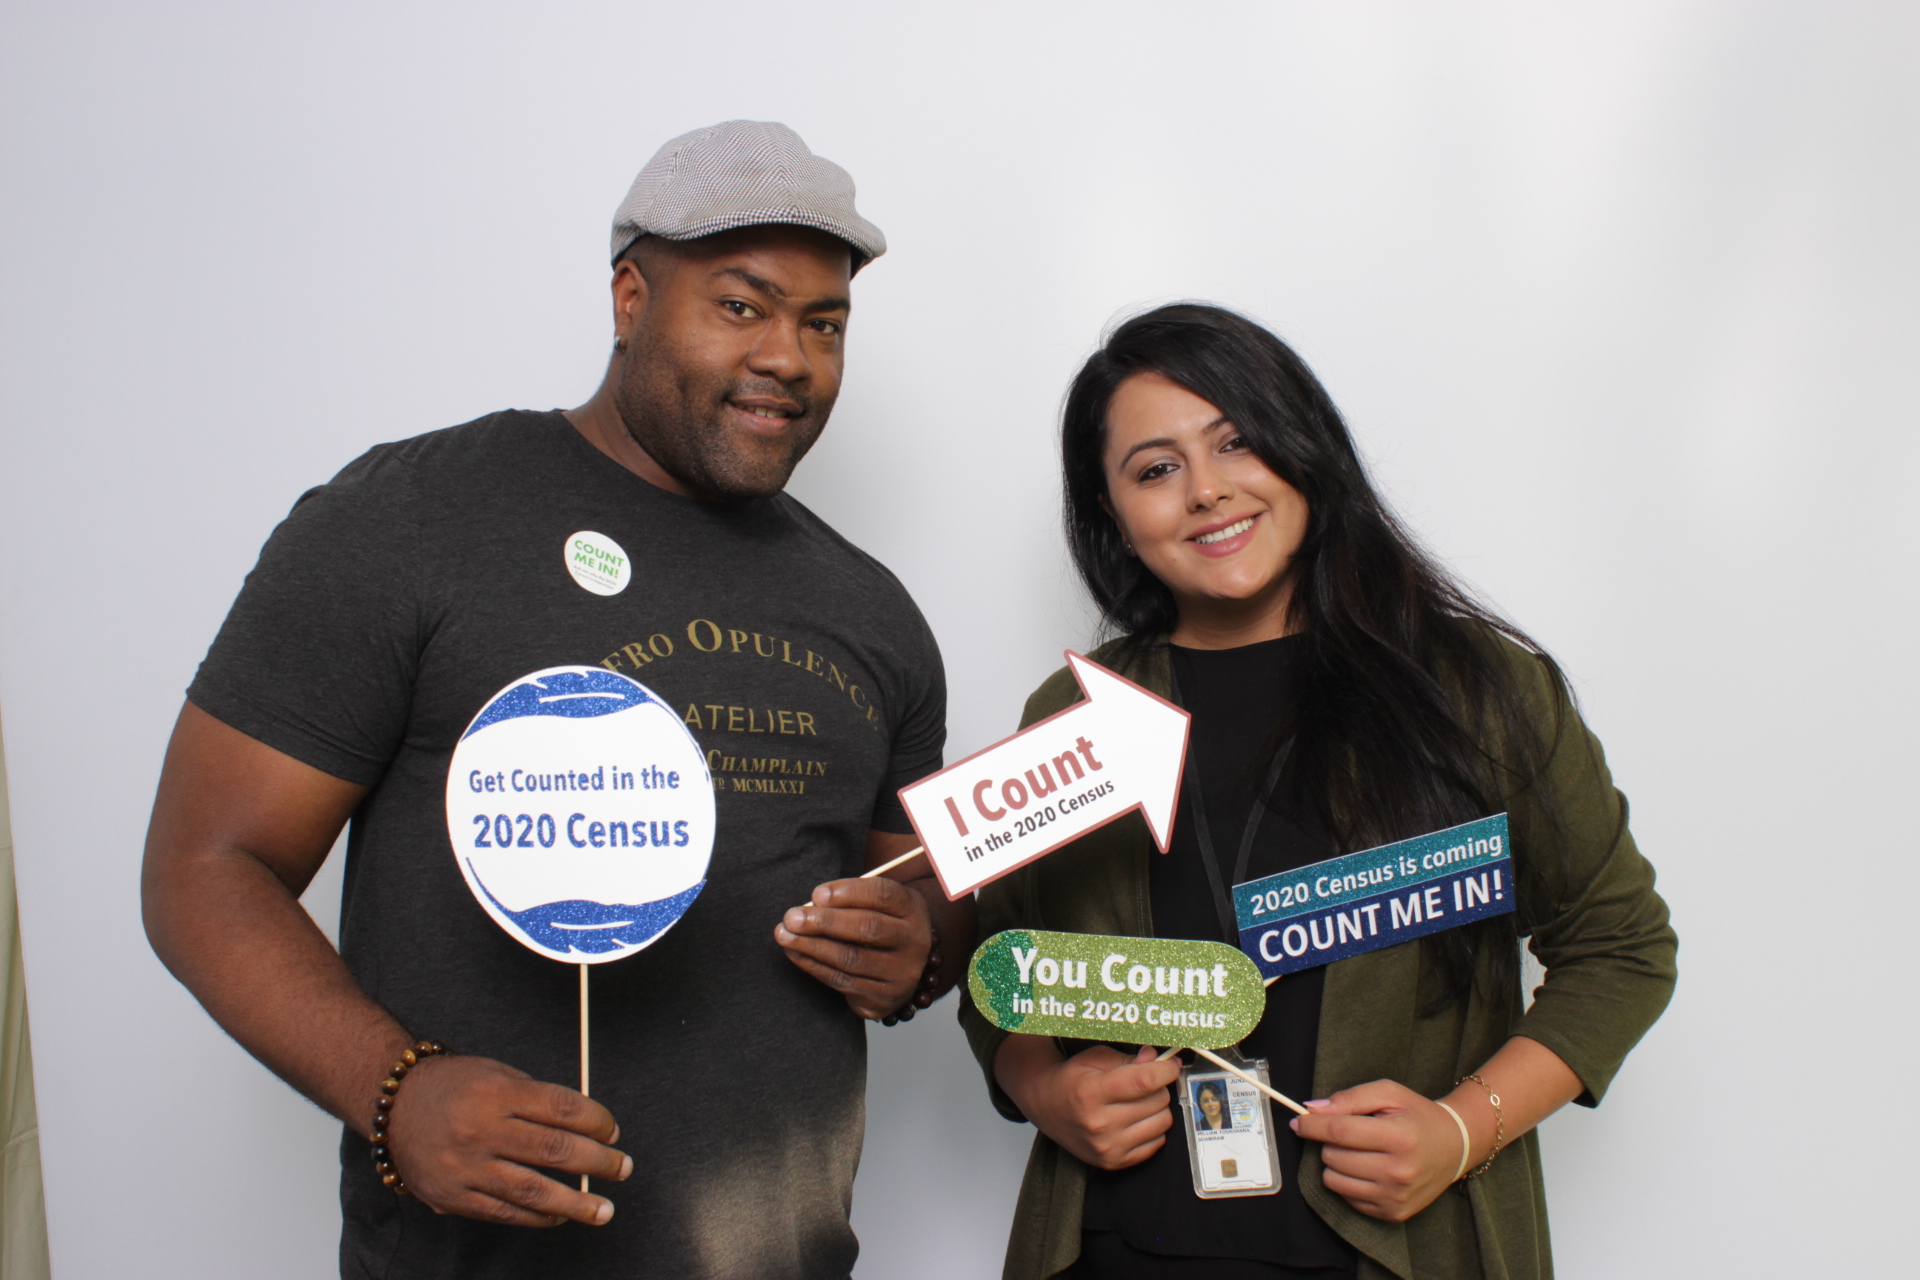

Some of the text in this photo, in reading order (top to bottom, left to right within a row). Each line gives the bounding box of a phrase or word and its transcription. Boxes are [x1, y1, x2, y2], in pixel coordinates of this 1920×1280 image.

[574, 540, 624, 567] COUNT
[574, 552, 619, 578] ME IN!
[600, 633, 673, 673] FRO
[684, 703, 817, 736] ATELIER
[469, 764, 680, 793] Get Counted in the
[707, 749, 828, 776] CHAMPLAIN
[712, 777, 805, 794] TD MCMLXXI
[943, 736, 1103, 837] I Count
[472, 812, 689, 848] 2020 Census
[964, 778, 1115, 862] in the 2020 Census
[1250, 834, 1502, 916] 2020 Census is coming
[1258, 869, 1504, 963] COUNT ME IN!
[1011, 946, 1228, 997] You Count
[1012, 992, 1225, 1028] in the 2020 Census
